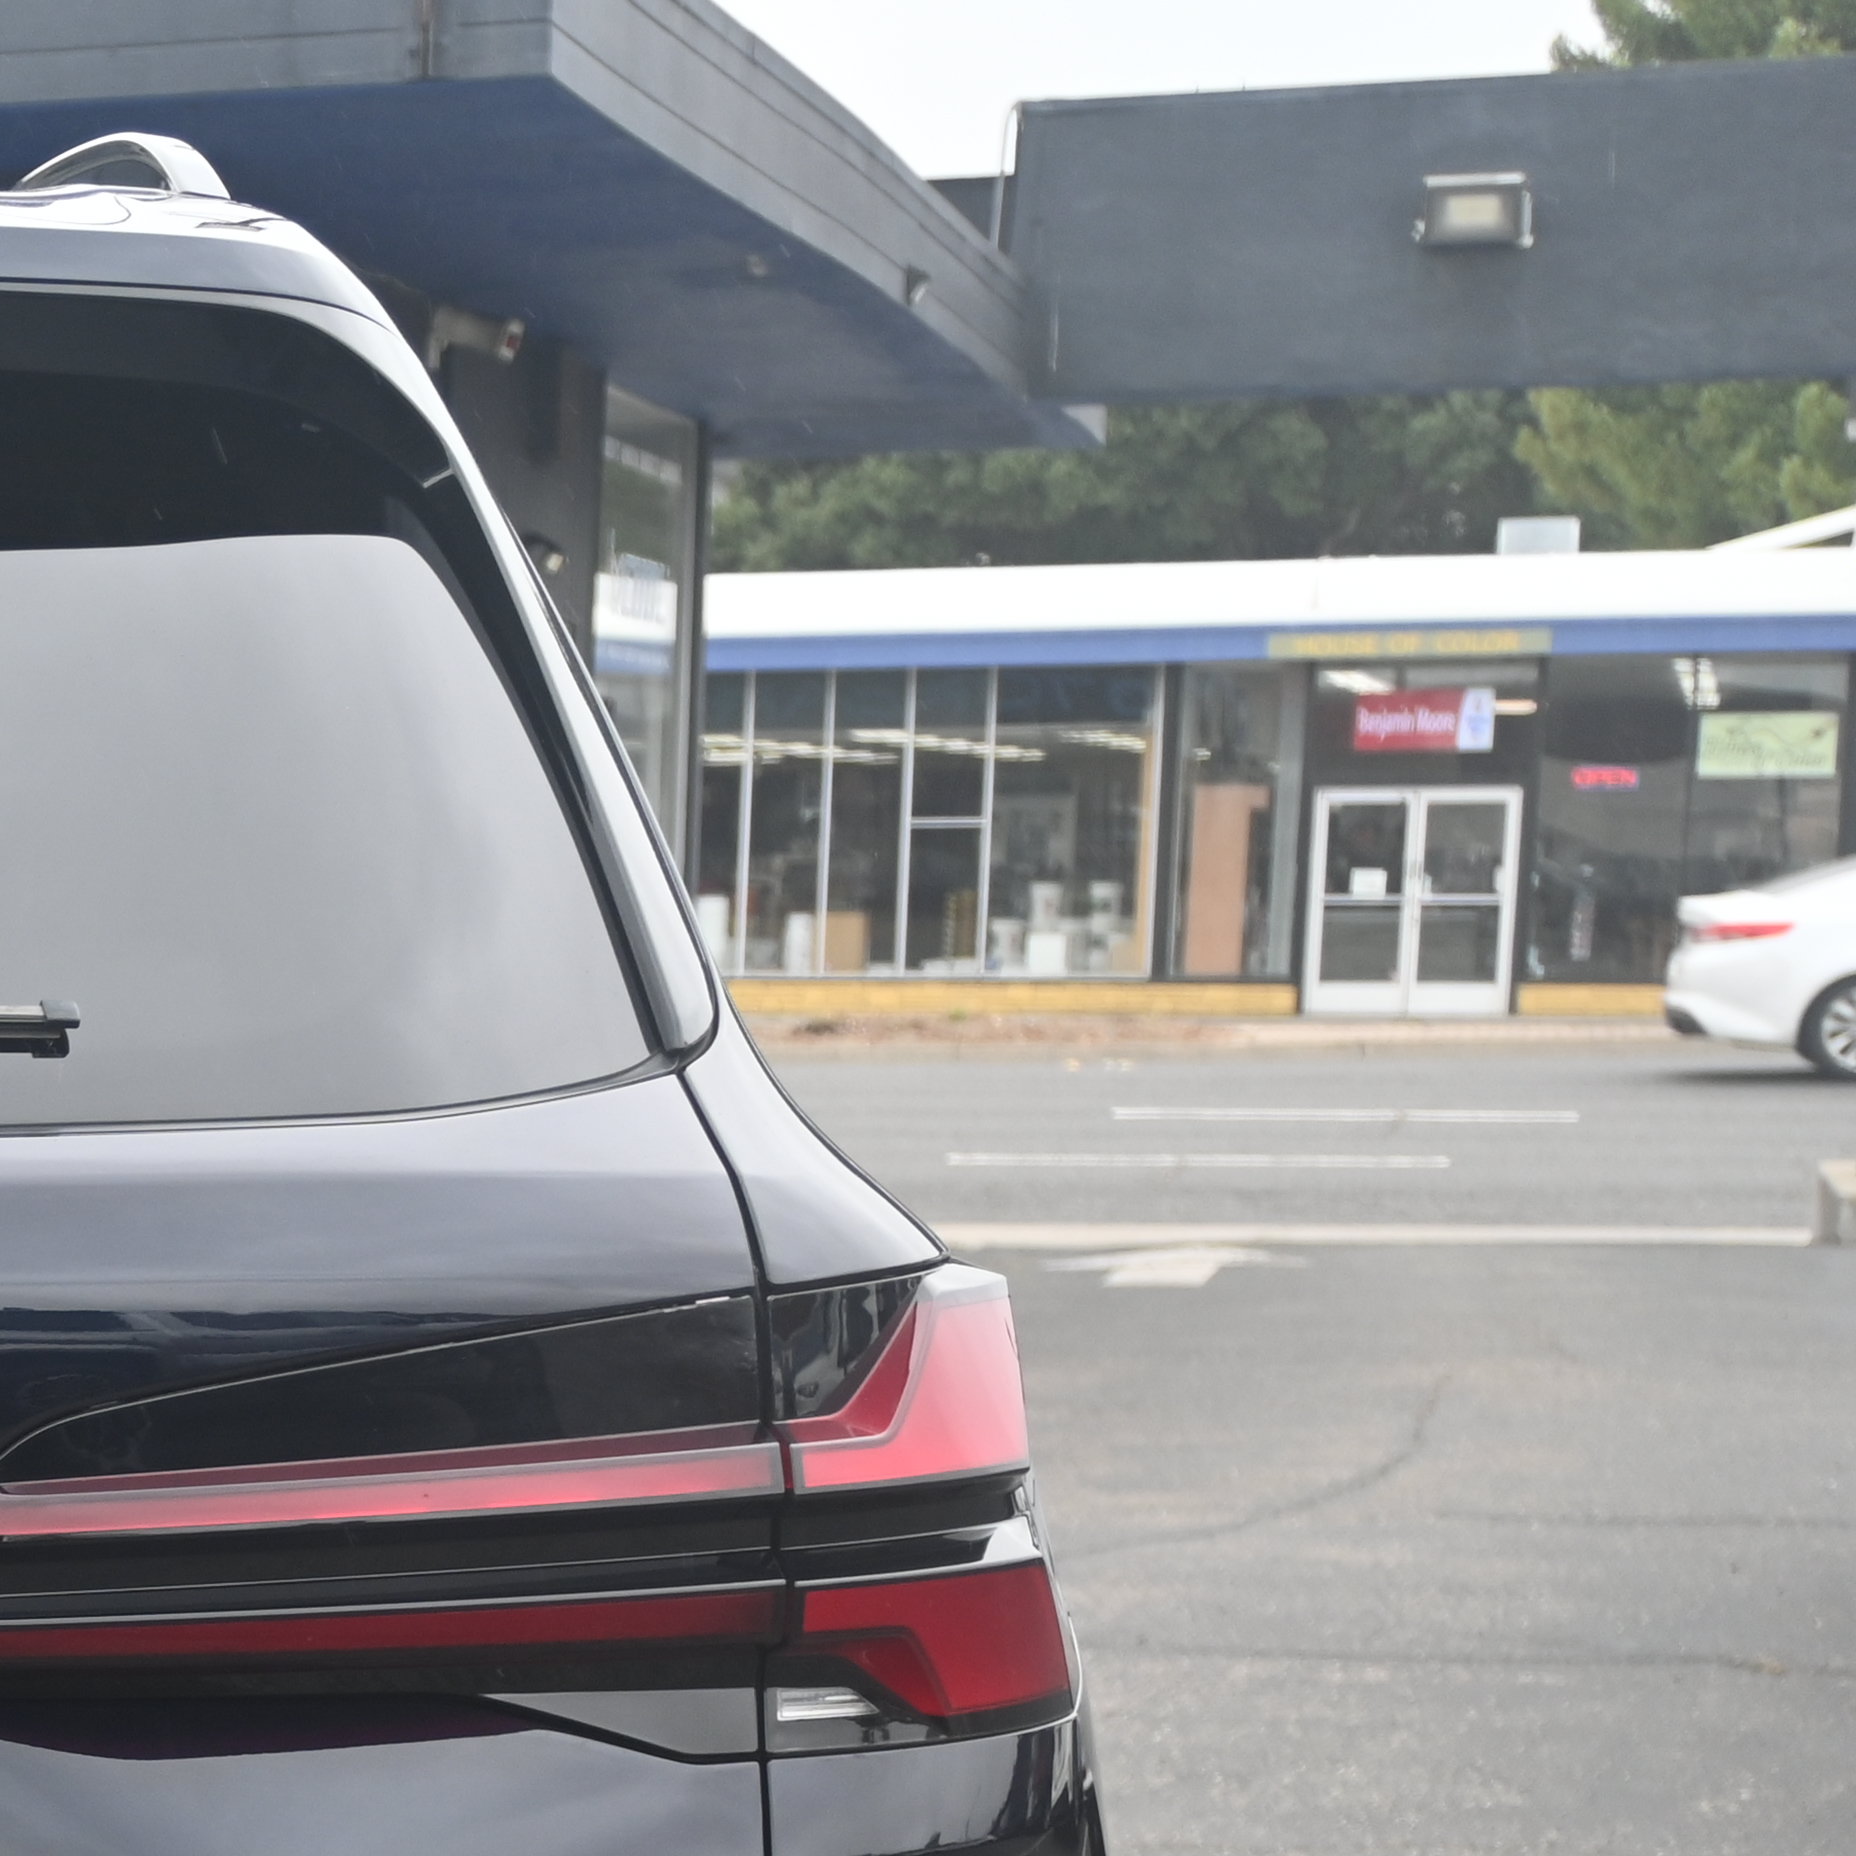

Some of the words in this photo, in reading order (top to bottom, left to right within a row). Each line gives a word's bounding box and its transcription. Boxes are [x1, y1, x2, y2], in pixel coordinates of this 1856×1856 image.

[1294, 633, 1377, 656] HOUSE
[1389, 632, 1419, 654] OF
[1358, 704, 1415, 741] Benjamin
[1417, 706, 1456, 732] Moore
